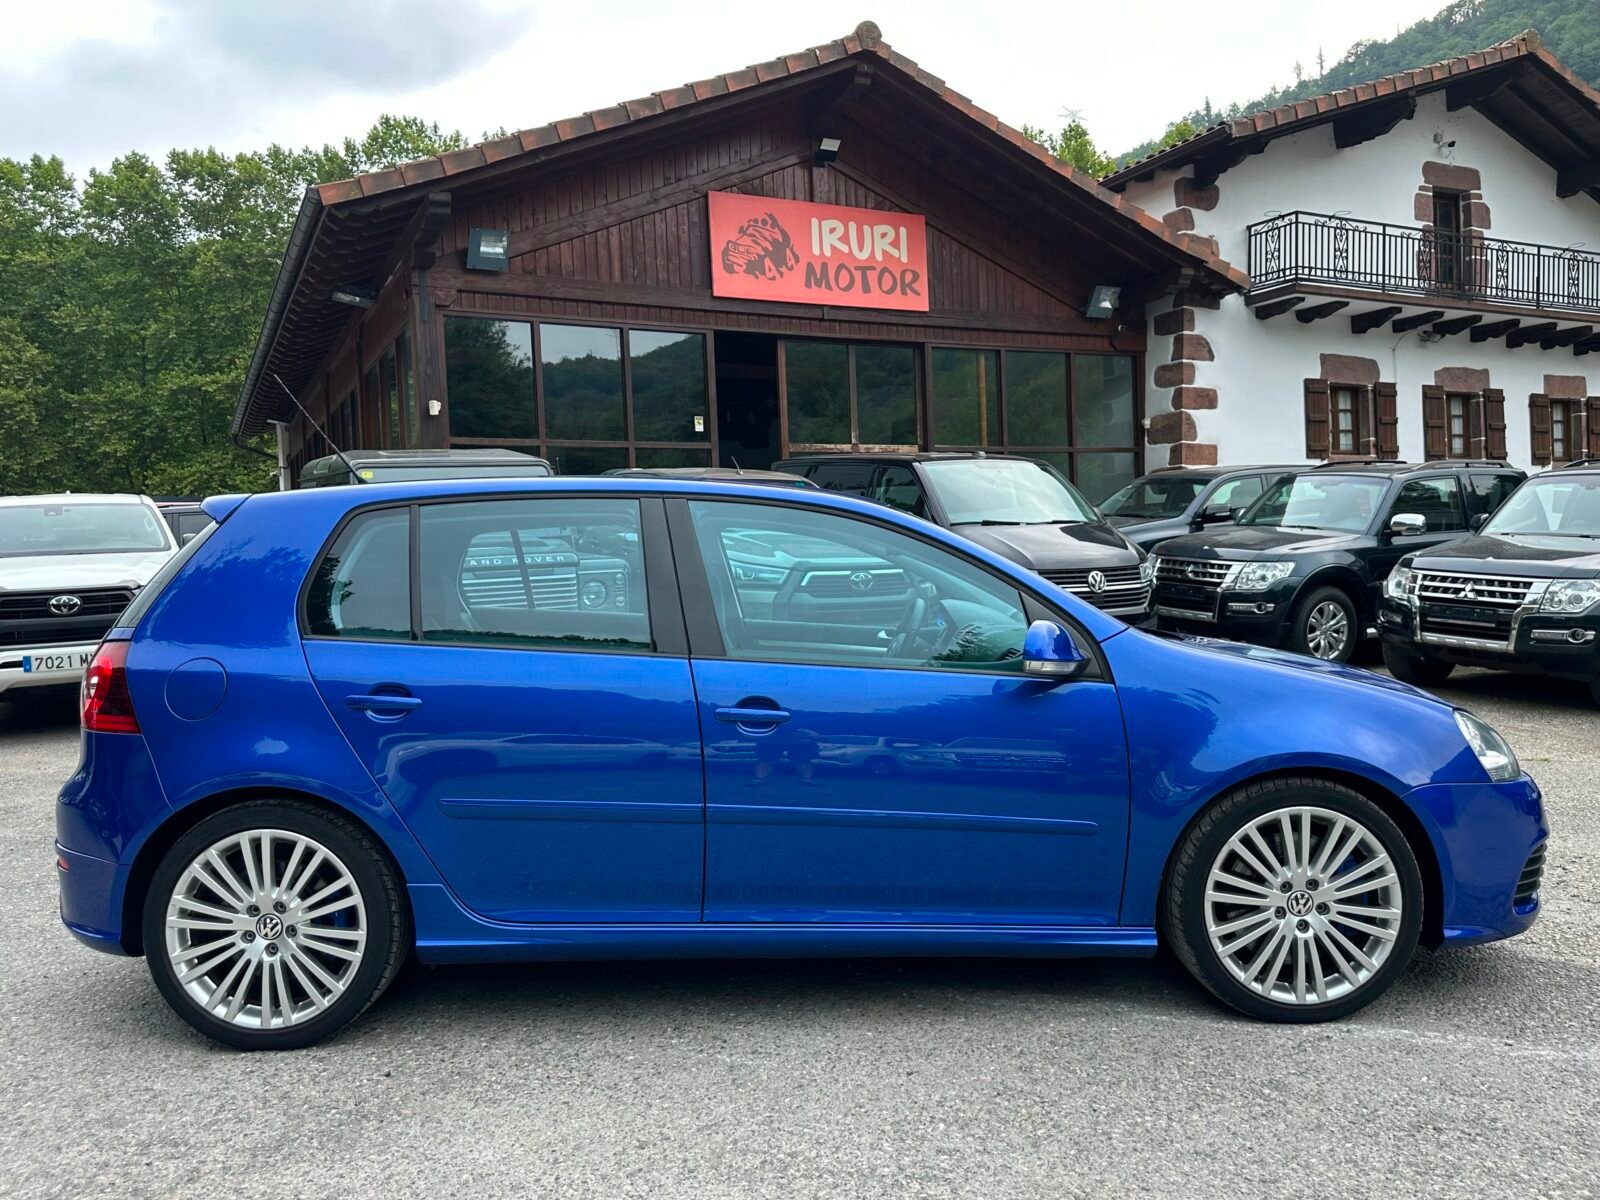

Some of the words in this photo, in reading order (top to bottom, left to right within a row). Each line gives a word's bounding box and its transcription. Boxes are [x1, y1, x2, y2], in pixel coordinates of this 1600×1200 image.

[811, 217, 908, 264] IRURI
[804, 261, 921, 297] MOTOR
[463, 558, 502, 567] AND
[34, 655, 73, 671] 7021
[80, 652, 93, 667] M
